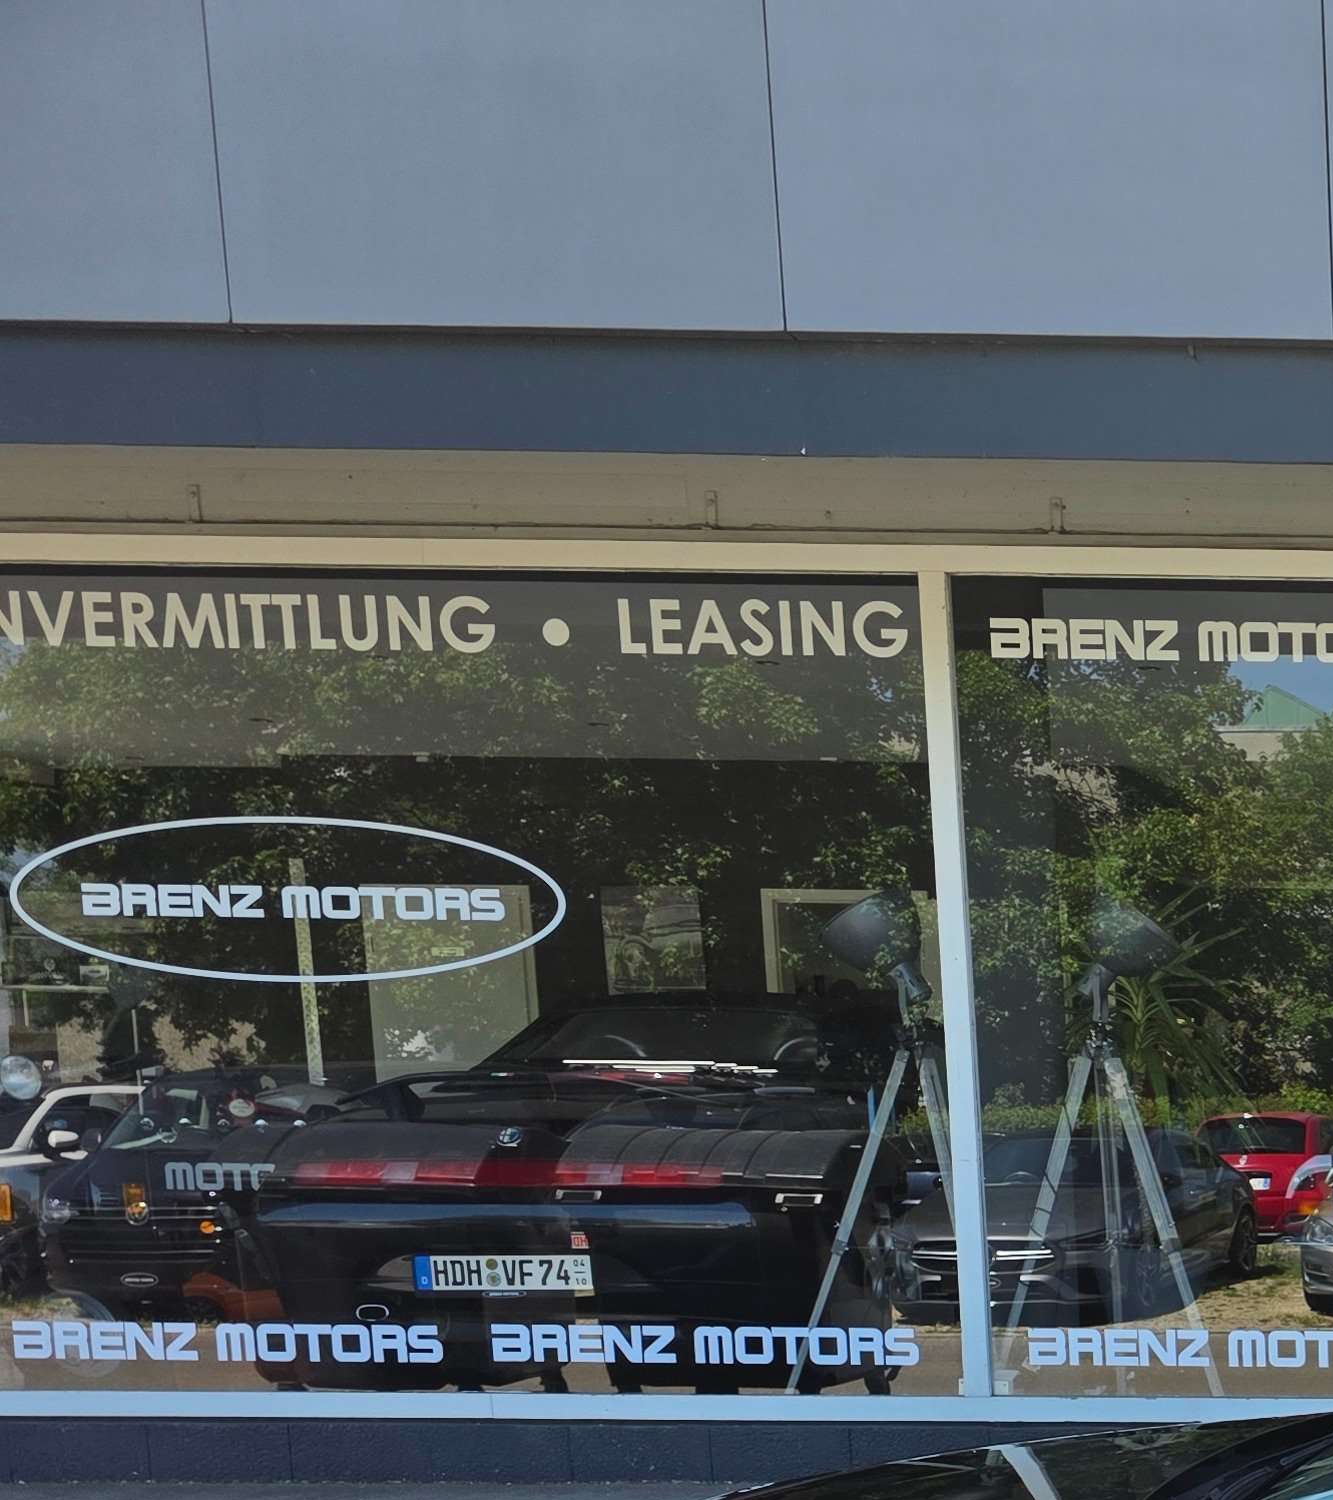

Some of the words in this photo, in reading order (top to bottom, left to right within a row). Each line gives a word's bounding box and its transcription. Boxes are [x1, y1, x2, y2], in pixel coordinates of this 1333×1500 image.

[618, 598, 908, 658] LEASING
[989, 617, 1180, 661] BRENZ
[80, 882, 264, 919] BRENZ
[281, 885, 506, 922] MOTORS
[433, 1259, 483, 1287] HDH
[502, 1259, 534, 1286] VF
[538, 1259, 571, 1286] 74
[11, 1321, 199, 1361] BRENZ
[214, 1323, 444, 1364] MOTORS
[490, 1324, 677, 1364] BRENZ
[693, 1324, 920, 1366] MOTORS
[1028, 1328, 1211, 1368] BRENZ
